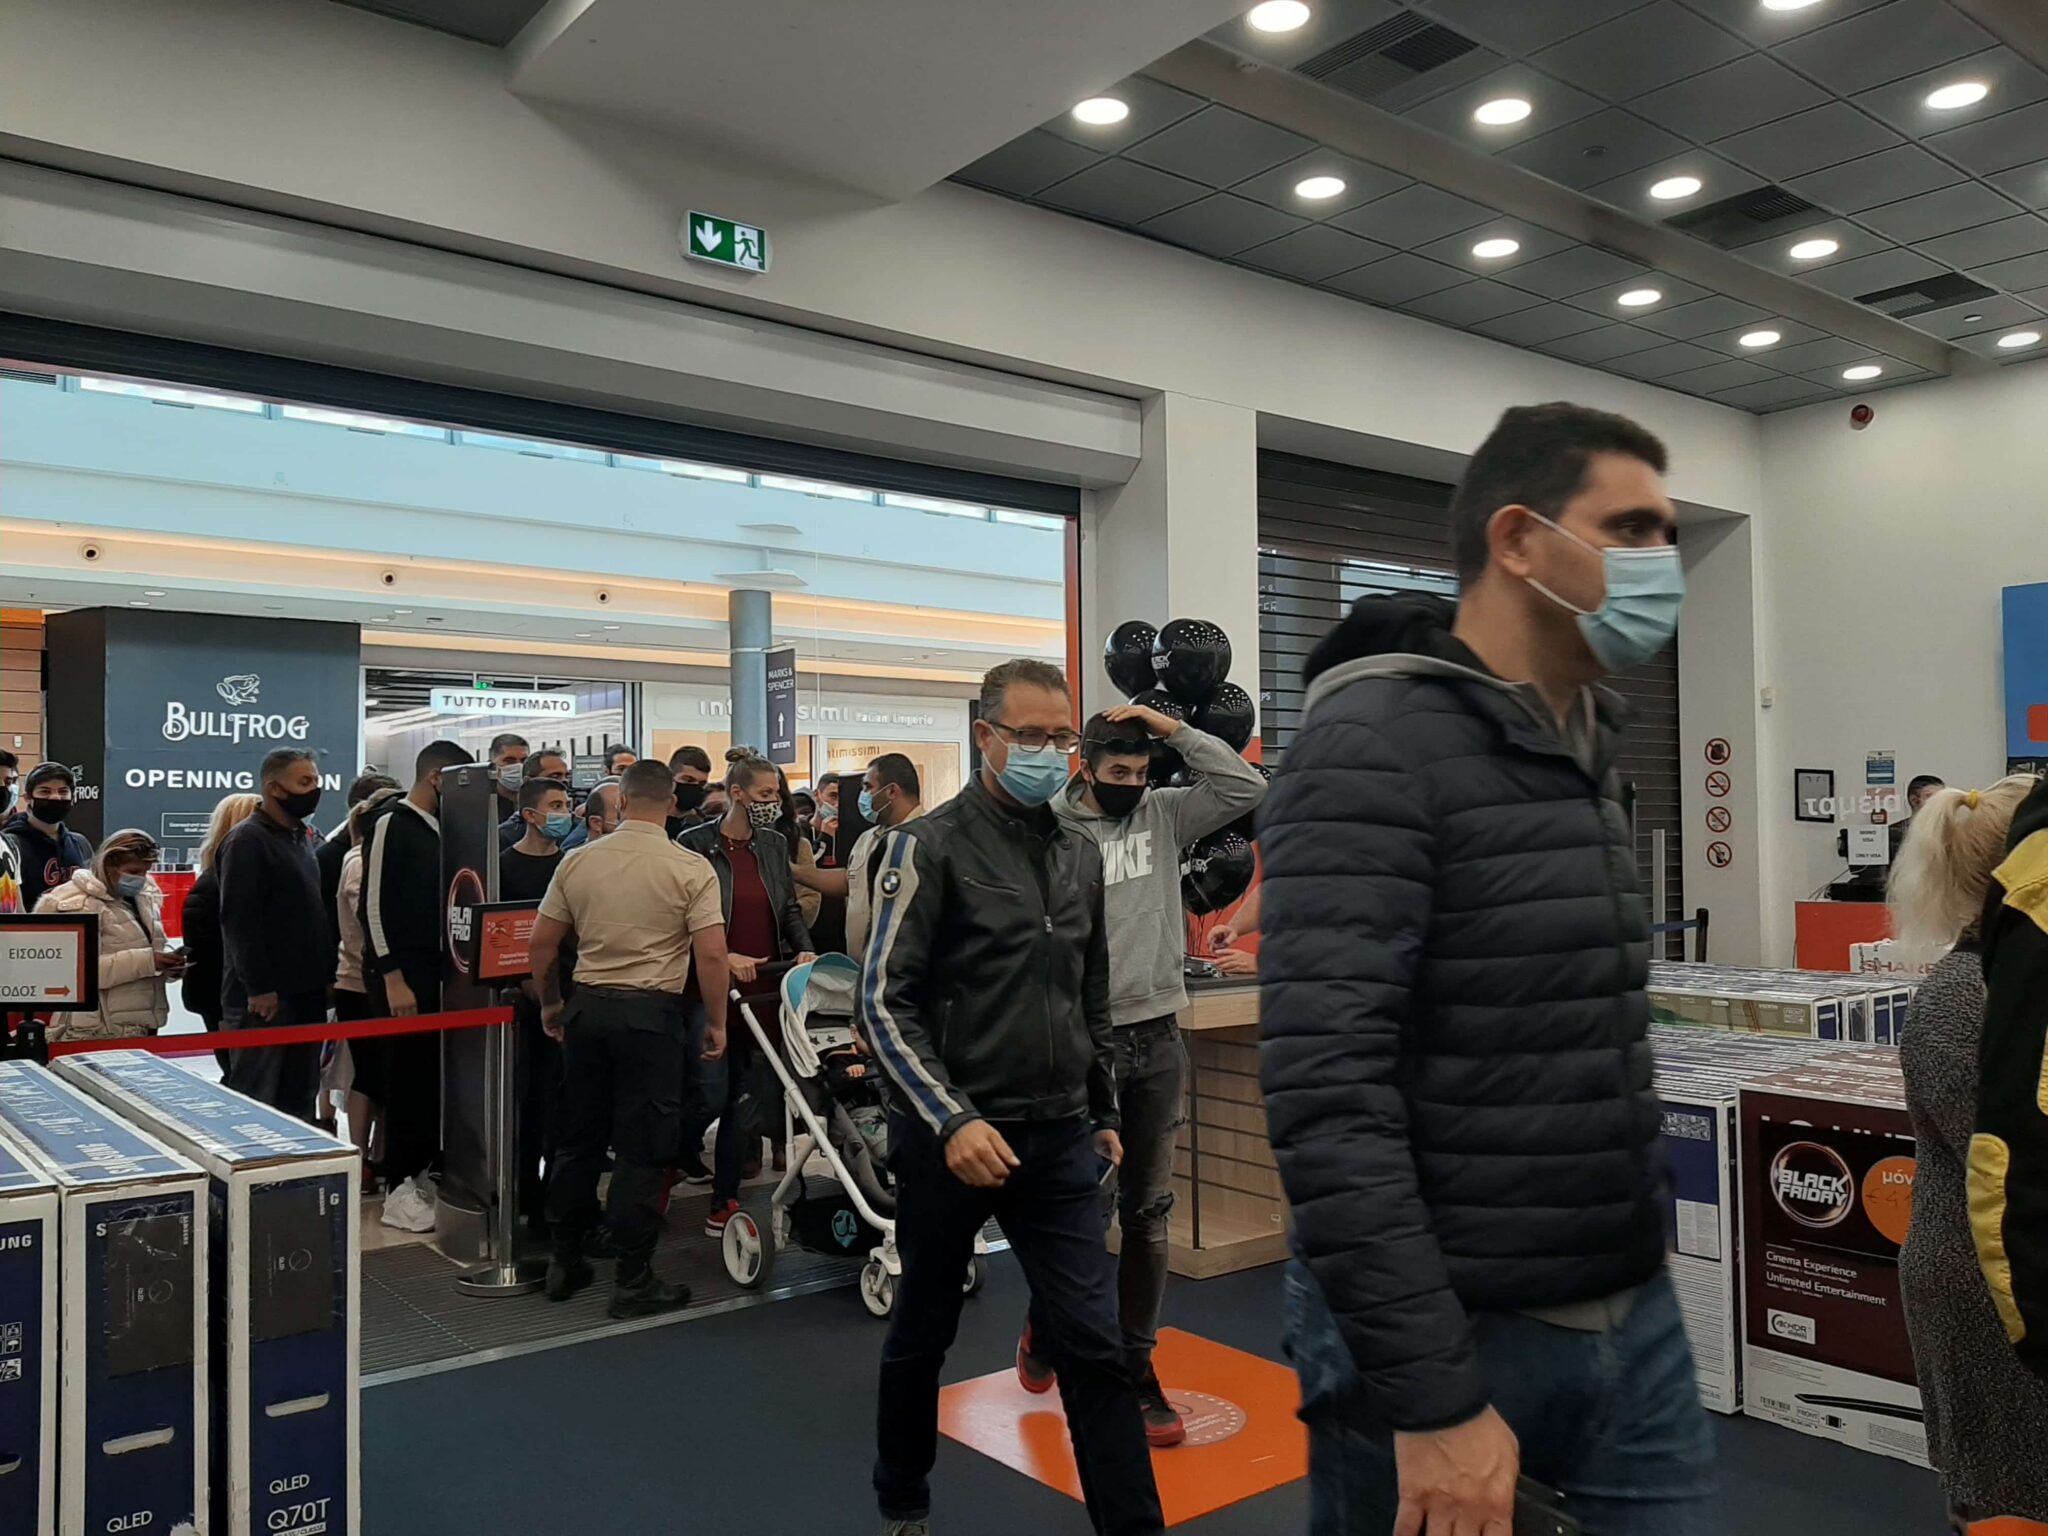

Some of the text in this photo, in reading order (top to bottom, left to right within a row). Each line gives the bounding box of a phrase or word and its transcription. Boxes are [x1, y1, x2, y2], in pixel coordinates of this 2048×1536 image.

[767, 679, 794, 691] SPENCER
[768, 668, 788, 679] MARKS
[442, 695, 571, 712] TUTTO FIRMATO
[125, 768, 254, 790] OPENING
[1804, 788, 1899, 820] ταμεία
[8, 948, 63, 960] ΕΙΣΟΔΟΣ
[1778, 1168, 1849, 1193] BLACK
[1882, 1168, 1914, 1185] μόν
[1778, 1183, 1848, 1207] FRIDAY
[1766, 1251, 1801, 1267] Cinema
[1803, 1258, 1858, 1279] Experience
[1766, 1271, 1812, 1290] Unlimited
[1814, 1282, 1888, 1306] Entertainment
[269, 1474, 310, 1495] QLED
[106, 1510, 153, 1534] QLED
[267, 1497, 331, 1530] Q70T
